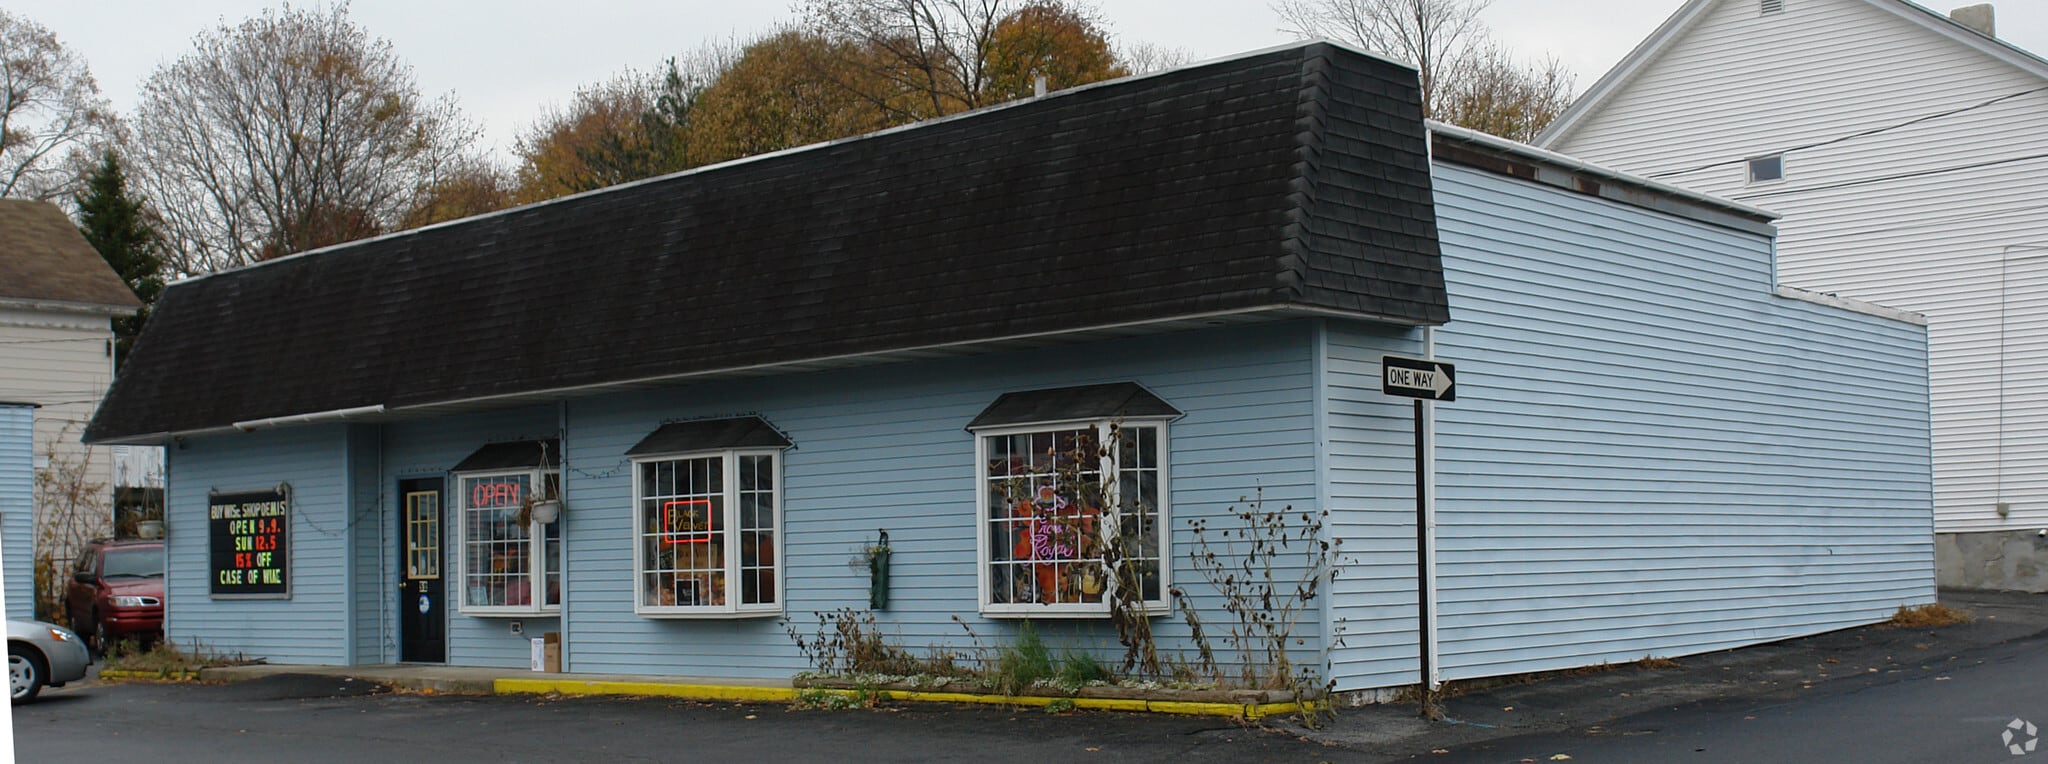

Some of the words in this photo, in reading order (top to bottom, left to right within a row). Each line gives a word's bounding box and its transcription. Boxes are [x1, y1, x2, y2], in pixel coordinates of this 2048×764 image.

[1390, 368, 1410, 386] ONE
[1413, 370, 1434, 388] WAY
[473, 483, 519, 507] OPEN
[211, 504, 224, 519] BUY
[242, 502, 260, 517] SHOP
[229, 519, 255, 534] OPEN
[235, 535, 252, 550] SUN
[235, 552, 252, 567] 15%
[256, 551, 271, 567] OFF
[220, 569, 242, 584] CASE
[247, 569, 258, 584] OF
